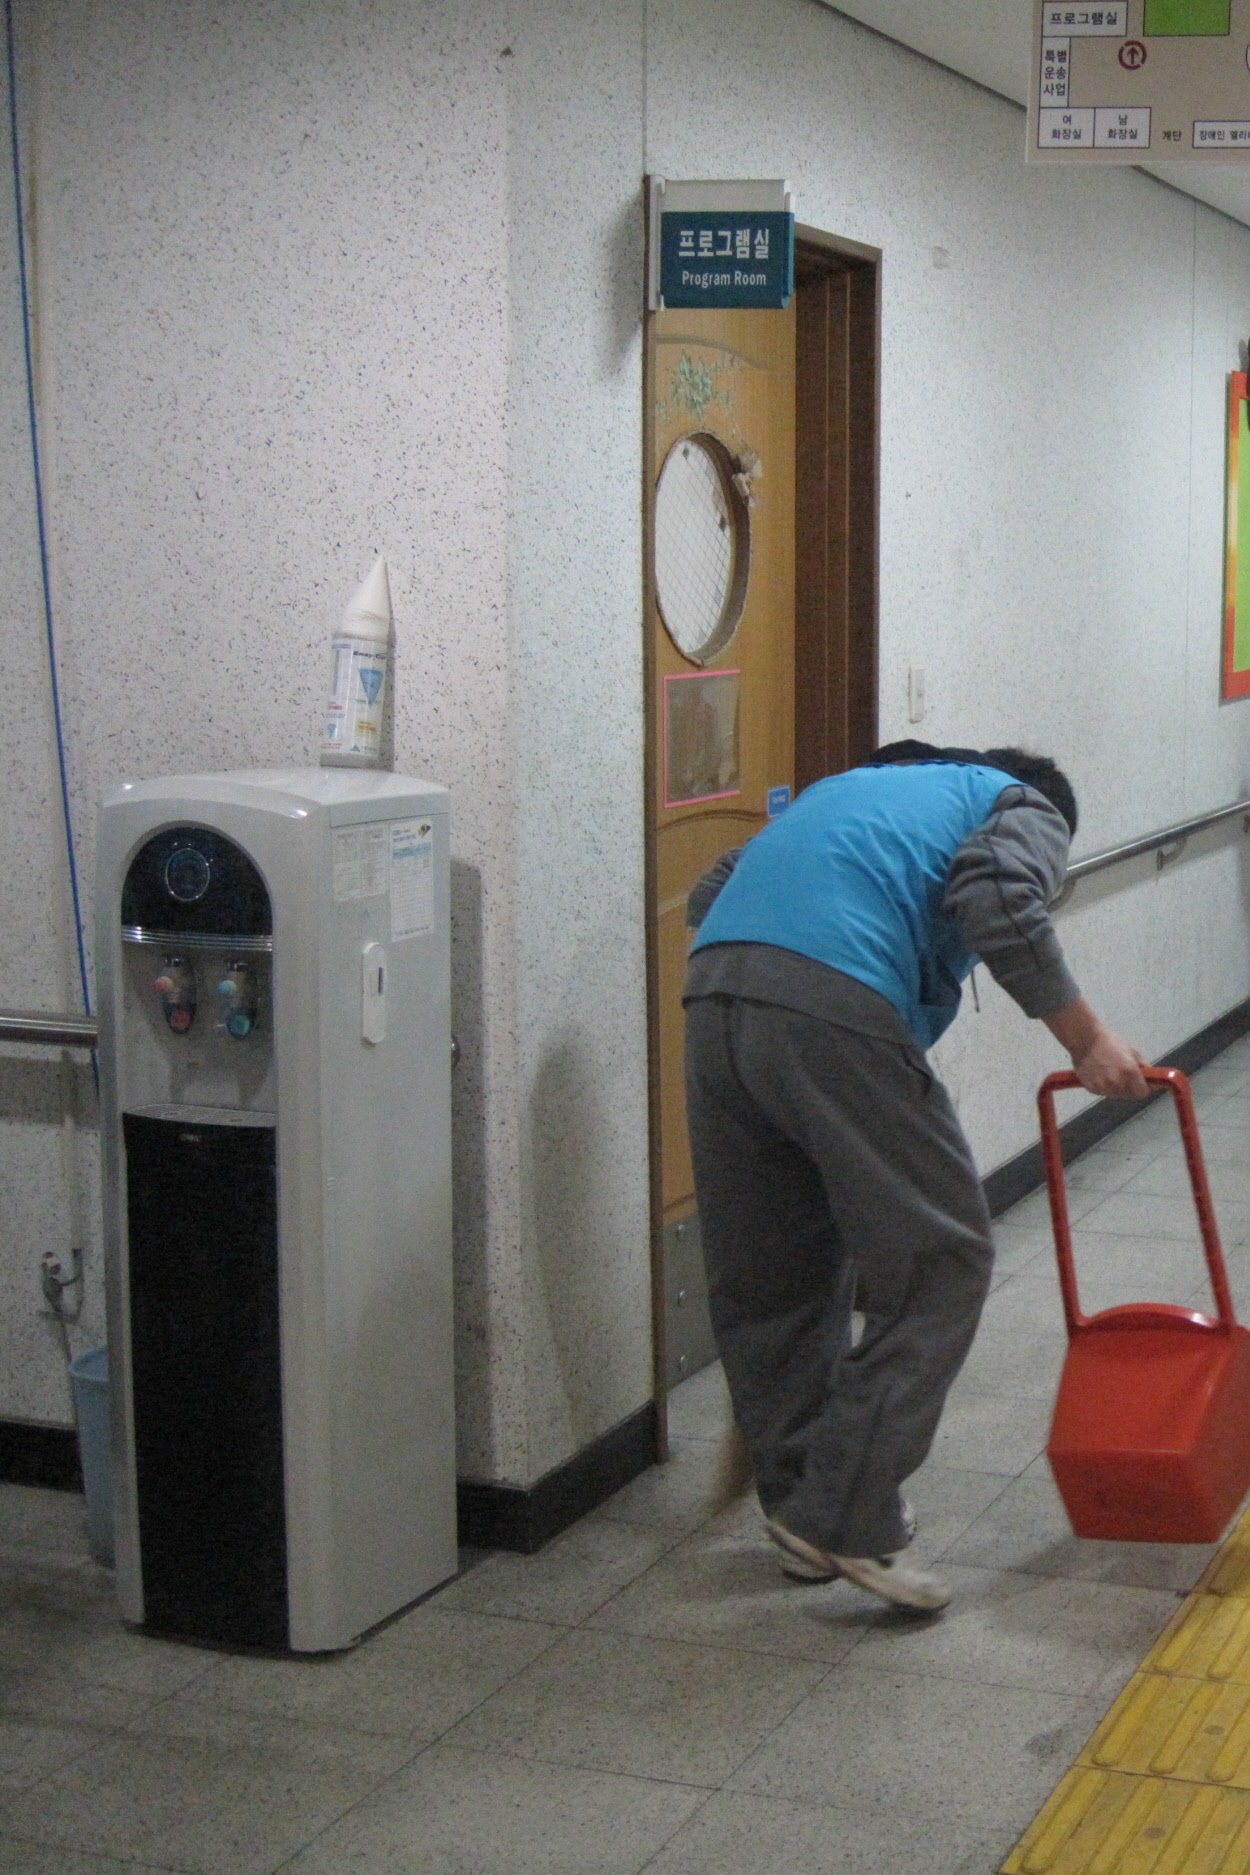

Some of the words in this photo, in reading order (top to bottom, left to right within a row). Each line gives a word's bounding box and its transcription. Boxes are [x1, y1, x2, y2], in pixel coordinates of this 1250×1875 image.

[1050, 12, 1118, 26] 프로그램실
[1044, 50, 1067, 63] 특별
[1044, 66, 1067, 80] 운송
[1043, 82, 1066, 97] 사업
[1062, 114, 1072, 126] 여
[1118, 114, 1128, 126] 남
[1051, 128, 1082, 140] 화장실
[1107, 128, 1138, 140] 화장실
[1162, 130, 1182, 142] 계단
[1199, 130, 1225, 141] 장애인
[678, 228, 770, 259] 프로그램실
[682, 270, 731, 288] Program
[734, 270, 767, 286] Room
